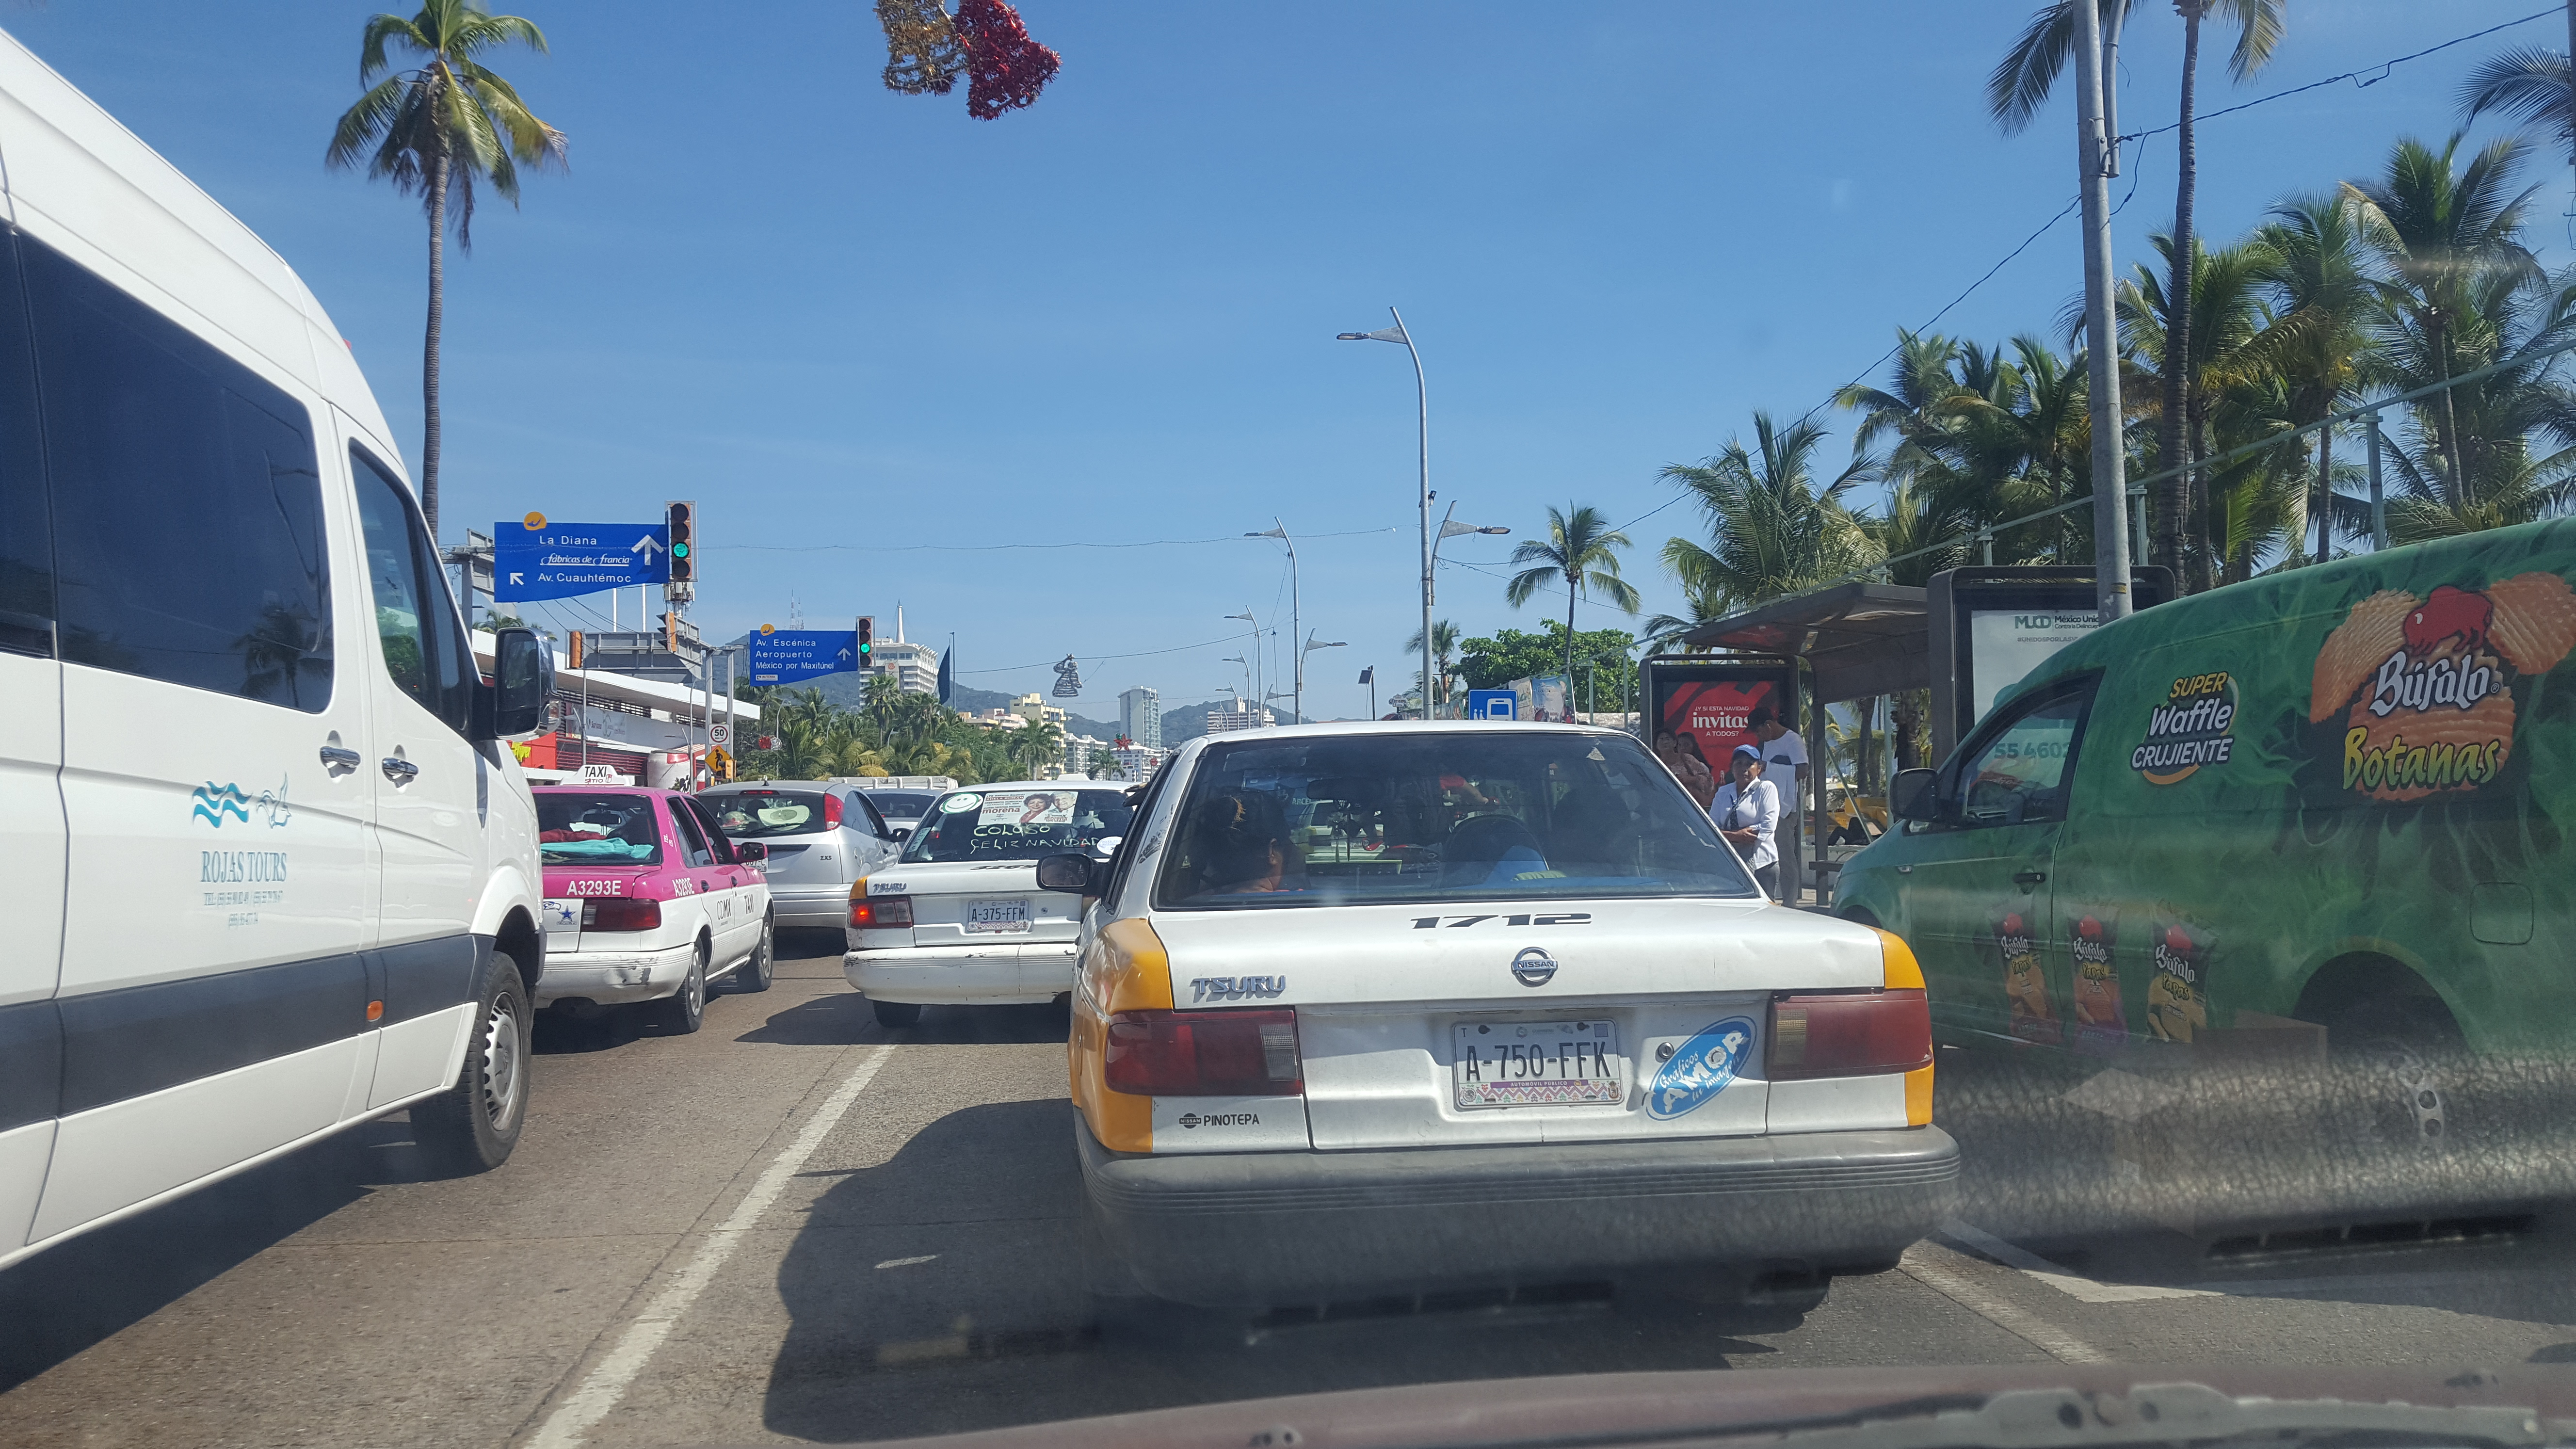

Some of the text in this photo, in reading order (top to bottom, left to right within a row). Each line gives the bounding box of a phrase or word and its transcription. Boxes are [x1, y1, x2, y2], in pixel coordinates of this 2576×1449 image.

[540, 536, 597, 545] La Diana
[593, 553, 629, 566] francia
[538, 573, 631, 582] Av. Cuauhtémoc
[2055, 614, 2081, 623] México
[773, 638, 816, 647] Escénica
[756, 651, 812, 660] Aeropuerto
[756, 661, 782, 669] México
[2170, 671, 2228, 698] SUPER
[2368, 651, 2490, 717] Búfalo
[2149, 697, 2232, 736] Waffle
[2132, 738, 2233, 768] CRUJIENTE
[2343, 725, 2501, 791] Botanas
[584, 766, 607, 777] TAXI
[200, 851, 287, 883] ROJAS TOURS
[566, 880, 622, 896] A3293E
[672, 877, 695, 897] A3293E
[717, 898, 732, 920] CDMX
[744, 894, 754, 915] TAXI
[971, 907, 1025, 921] A-375-FFM
[1410, 913, 1592, 929] 1712
[1191, 975, 1287, 996] TSURU
[2162, 971, 2190, 1001] Papas
[1461, 1028, 1467, 1037] T
[1466, 1041, 1611, 1081] A-750-FFK
[1659, 1050, 1699, 1089] Gráficos
[1663, 1030, 1750, 1113] AMOR
[1704, 1054, 1741, 1089] imagen
[1203, 1113, 1260, 1127] PINOTEPA
